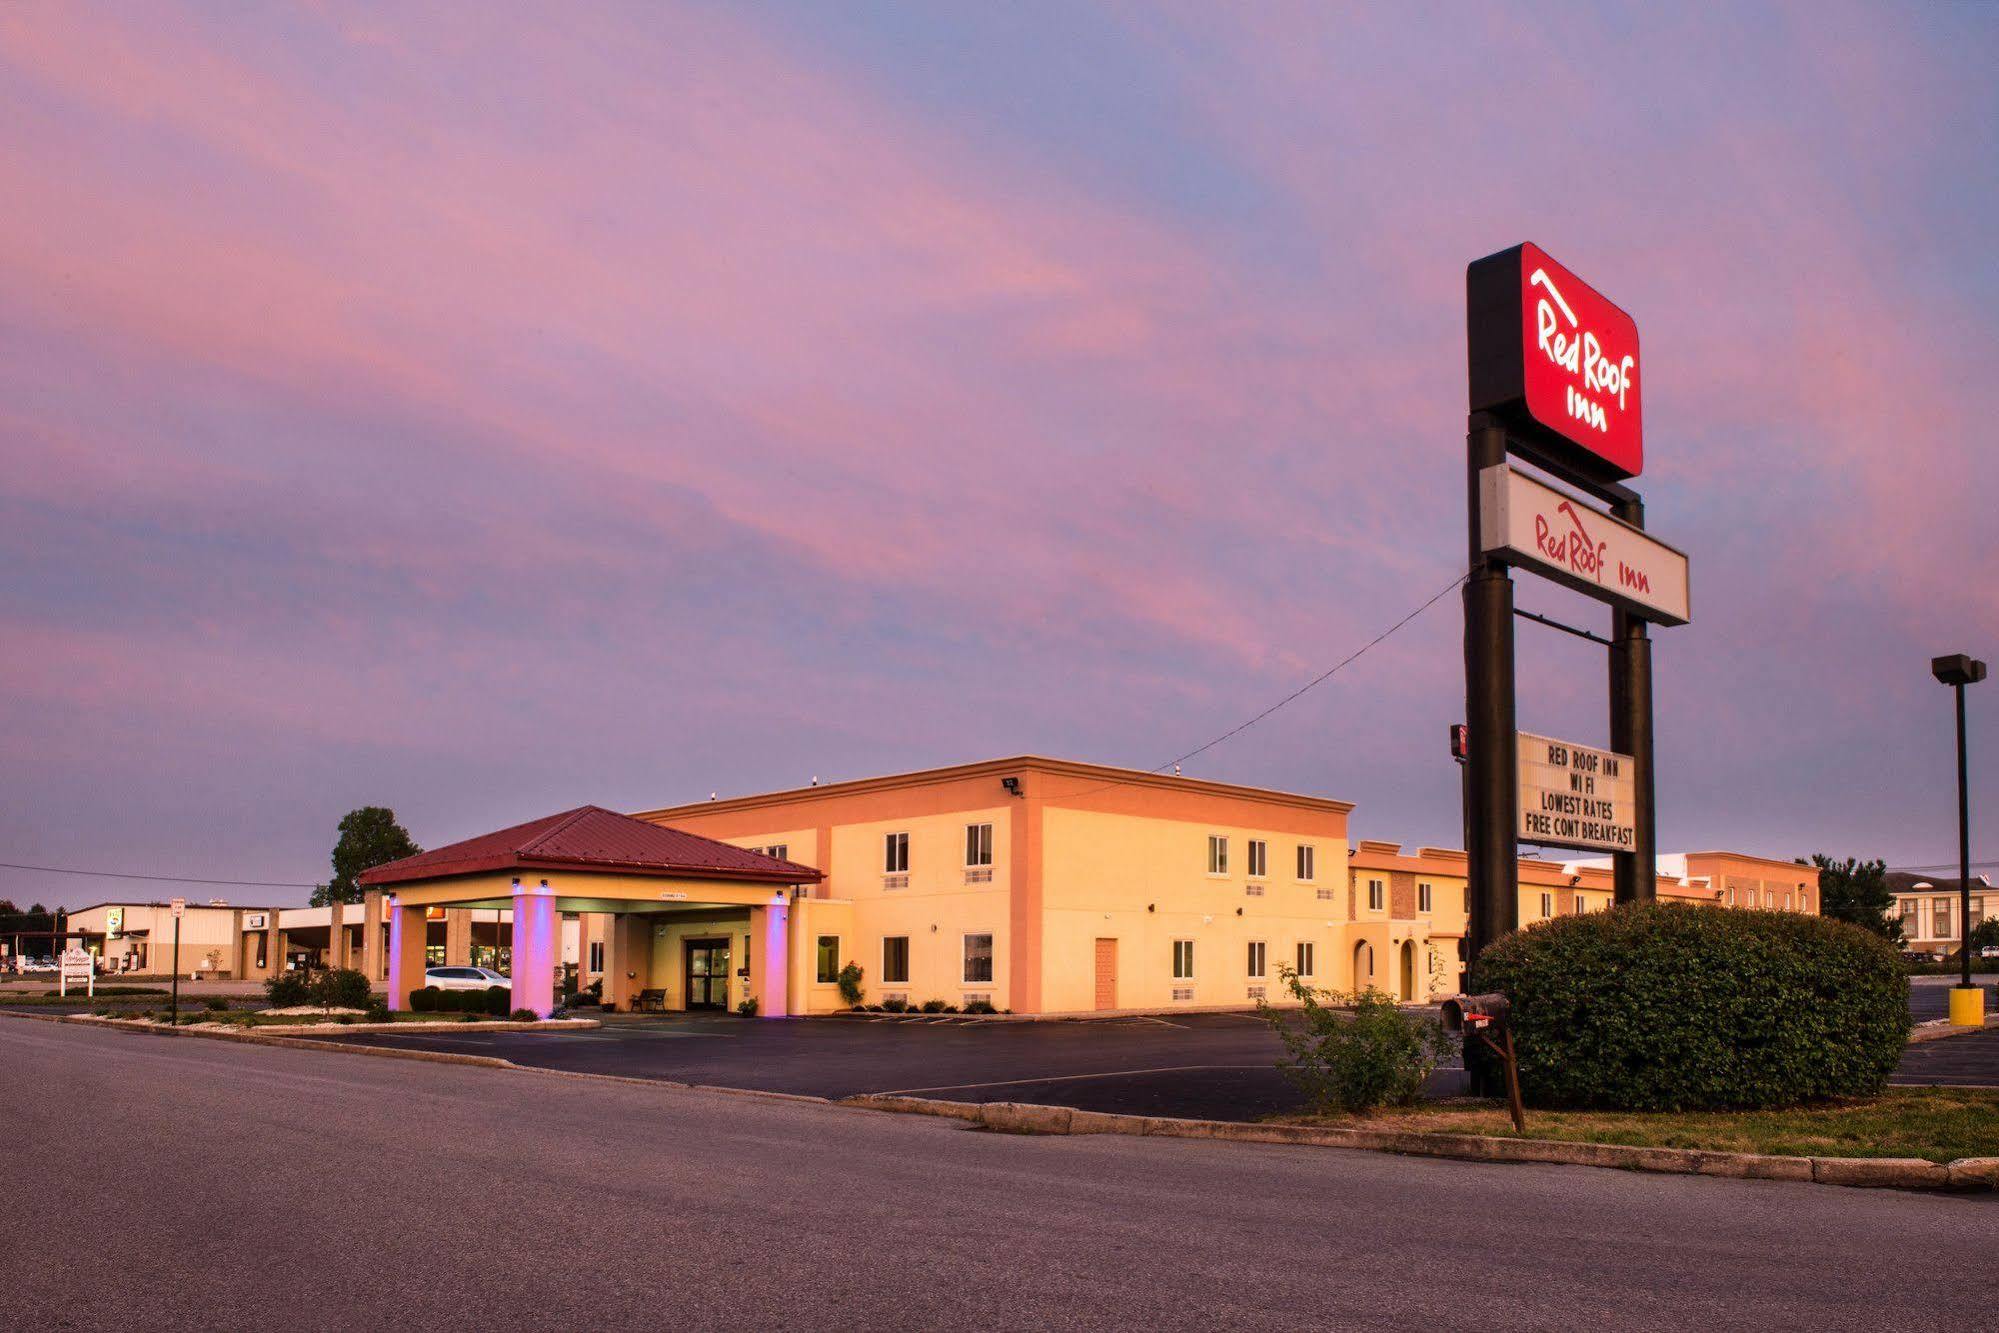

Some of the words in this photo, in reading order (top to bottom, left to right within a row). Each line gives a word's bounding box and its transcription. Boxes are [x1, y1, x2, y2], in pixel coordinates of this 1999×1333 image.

[1537, 298, 1580, 375] Red
[1583, 331, 1635, 411] Roof
[1566, 384, 1608, 433] Inn
[1535, 514, 1566, 562] Red
[1569, 530, 1607, 584] Roof
[1618, 561, 1650, 594] Inn
[1548, 745, 1568, 767] RED
[1573, 751, 1598, 773] ROOF
[1603, 758, 1619, 777] INN
[1570, 773, 1582, 792] WI
[1586, 776, 1594, 794] FI
[1542, 792, 1582, 815] LOWEST
[1584, 799, 1613, 820] RATES
[1526, 813, 1551, 835] FREE
[1554, 818, 1580, 838] CONT
[1582, 822, 1633, 845] BREAKFAST
